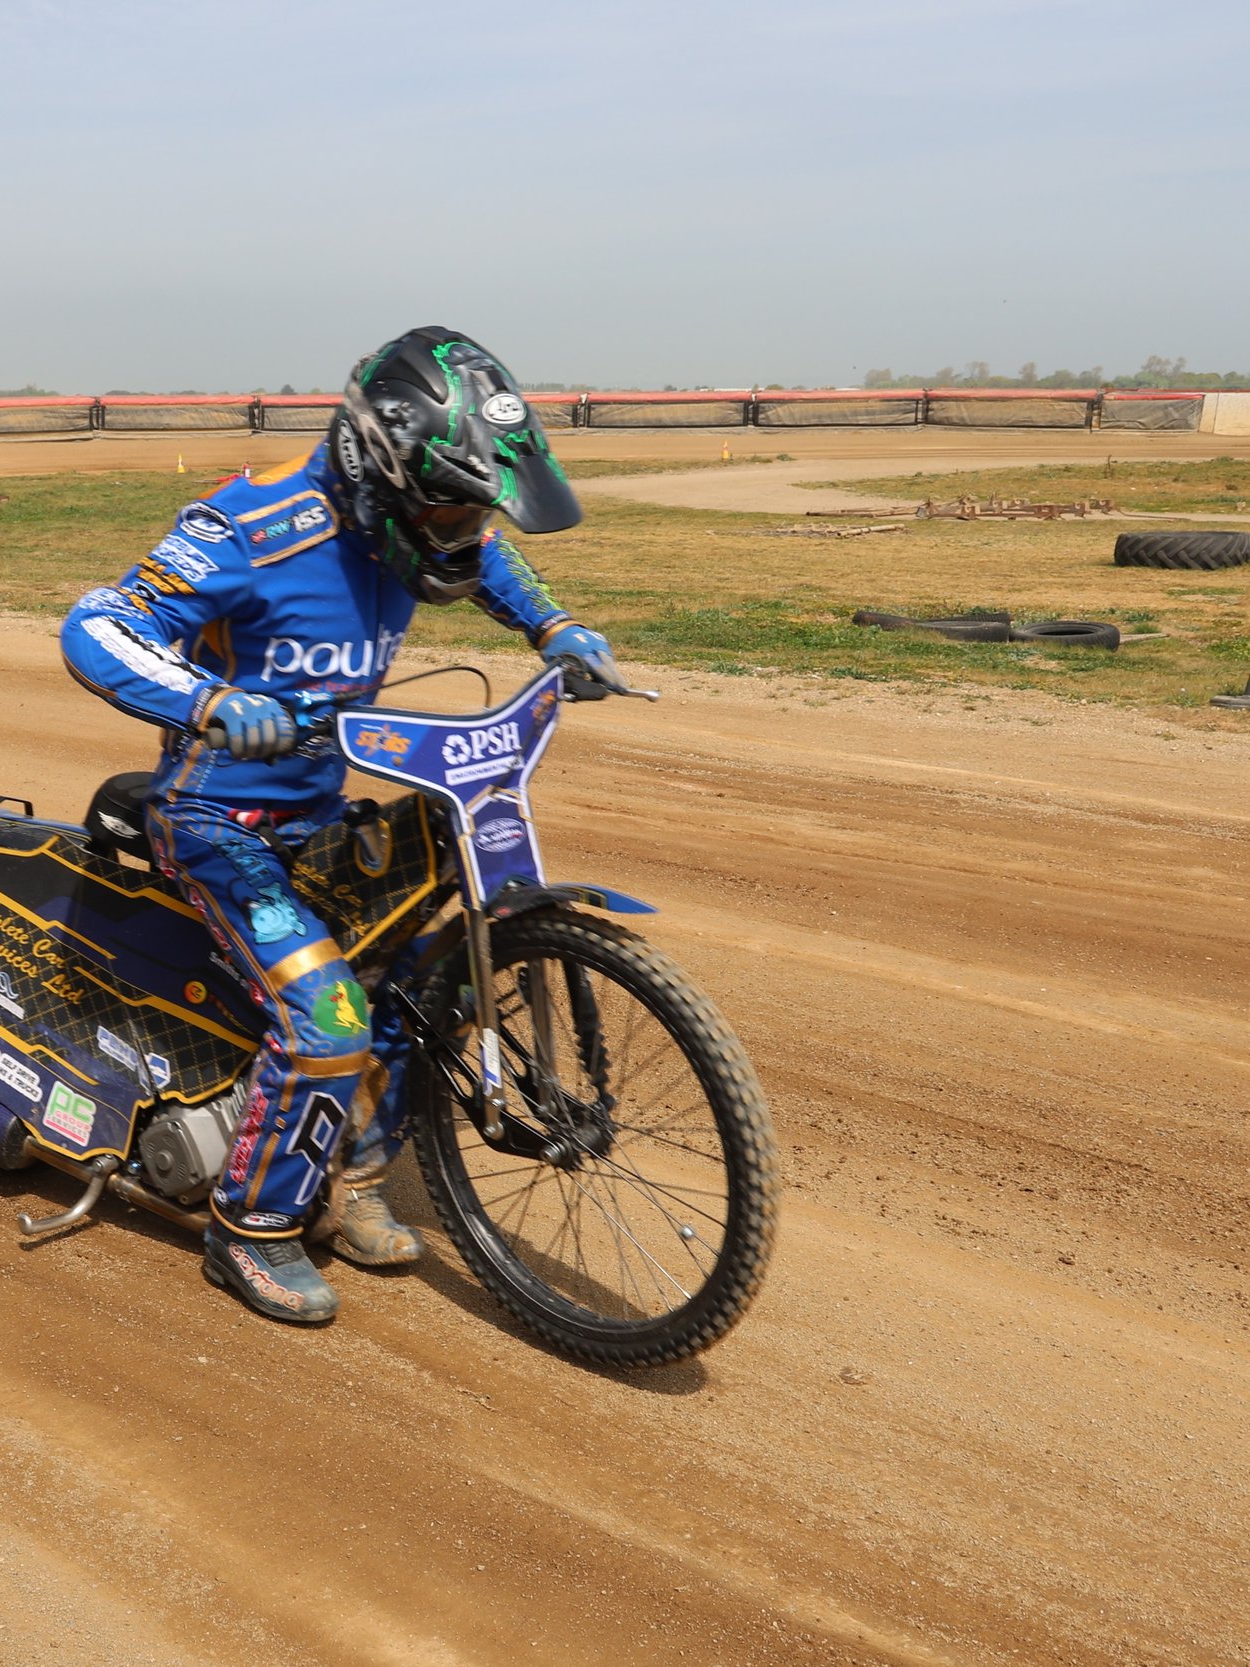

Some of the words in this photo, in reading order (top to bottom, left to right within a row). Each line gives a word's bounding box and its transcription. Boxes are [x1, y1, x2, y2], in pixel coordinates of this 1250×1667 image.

[468, 721, 522, 760] PSH
[32, 938, 65, 968] Car
[40, 974, 84, 1005] Ltd
[14, 1077, 39, 1098] TRUCKS
[16, 1066, 36, 1083] DRIVE
[228, 1242, 305, 1312] daytona
